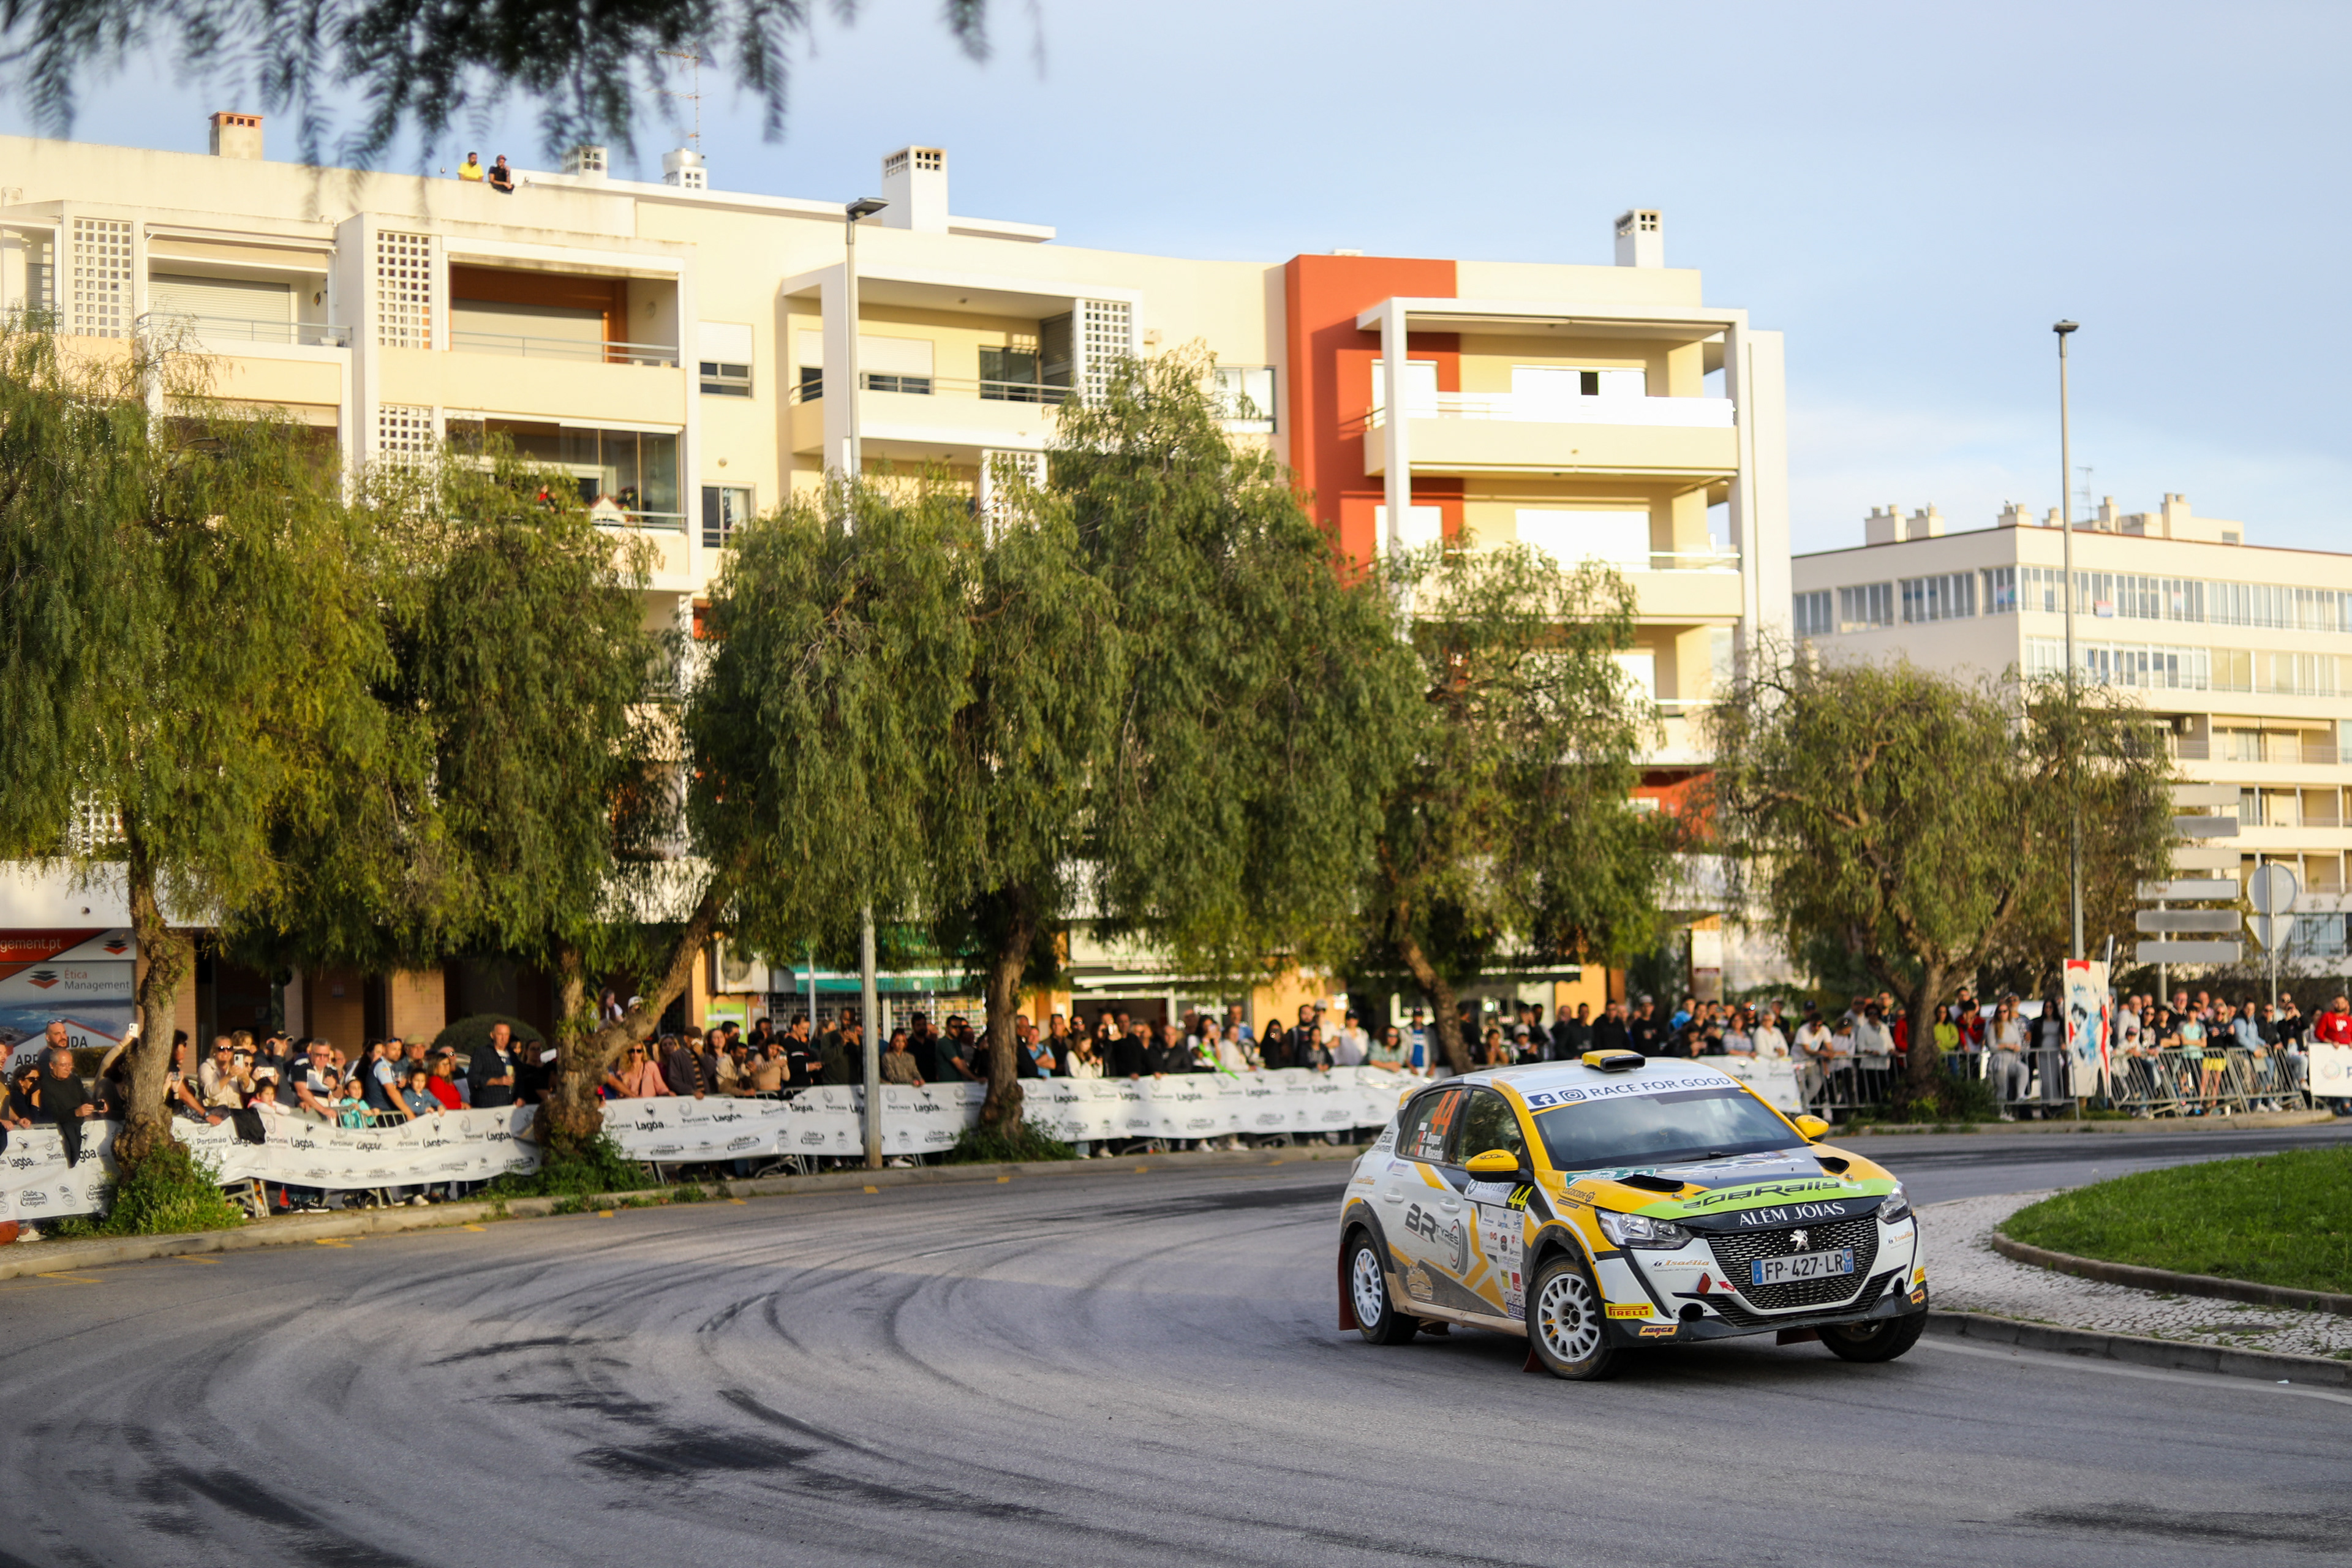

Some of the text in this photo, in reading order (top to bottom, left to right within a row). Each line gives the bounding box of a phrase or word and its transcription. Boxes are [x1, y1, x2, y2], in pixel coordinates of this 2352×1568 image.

[64, 967, 88, 979] Ética
[64, 981, 130, 992] Management
[1588, 1077, 1732, 1097] RACE FOR GOOD
[913, 1103, 940, 1114] Lagoa
[1431, 1090, 1463, 1136] 44
[635, 1120, 665, 1132] Lagoa
[290, 1136, 315, 1152] Lagoa
[79, 1148, 97, 1163] goa
[7, 1156, 34, 1170] Lagoa
[1477, 1182, 1512, 1194] SOLVERDE
[1562, 1187, 1587, 1199] LOGOCODE
[1507, 1184, 1534, 1211] 44
[1740, 1202, 1845, 1226] ALÉM JÓIAS
[1404, 1202, 1436, 1244] BR
[1435, 1224, 1459, 1246] TYRES
[1844, 1262, 1852, 1271] 17
[1608, 1305, 1649, 1316] PIRELLI
